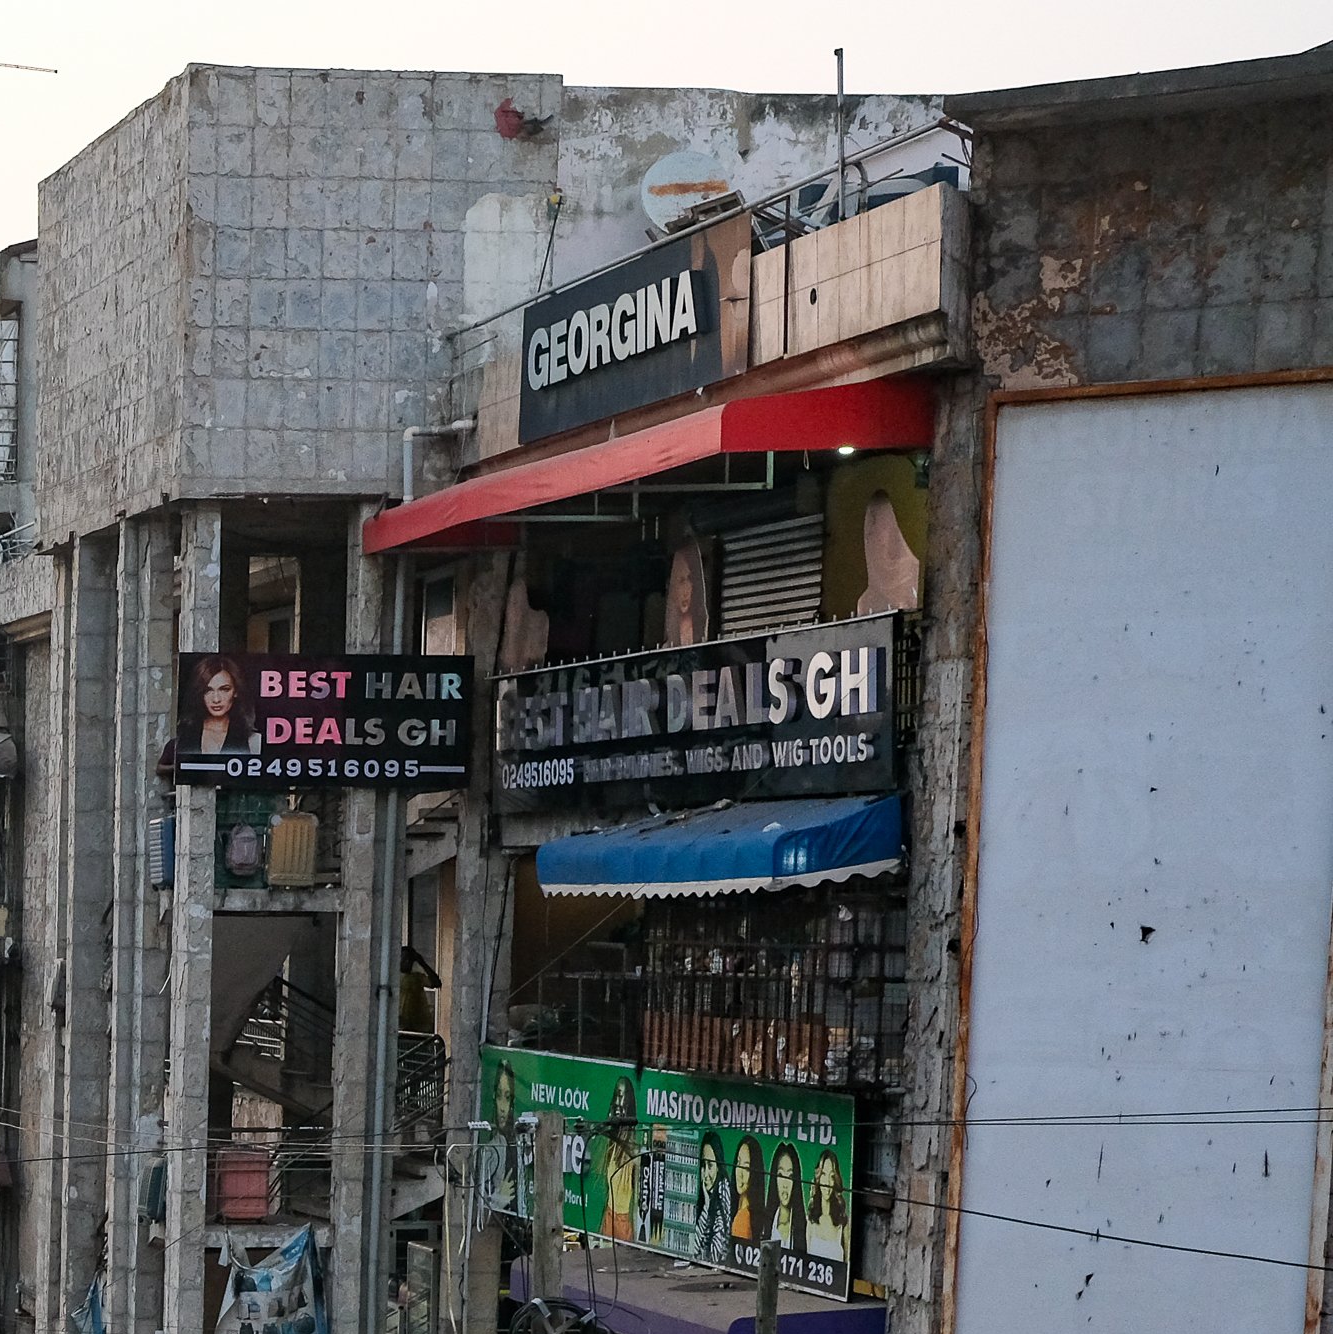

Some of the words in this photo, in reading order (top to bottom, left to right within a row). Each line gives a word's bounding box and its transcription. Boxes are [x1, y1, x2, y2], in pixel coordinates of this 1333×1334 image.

[528, 269, 698, 390] GEORGINA
[259, 670, 352, 699] BEST
[365, 672, 463, 700] HAIR
[667, 657, 793, 732] DEALS
[805, 646, 875, 720] GH
[266, 717, 386, 745] DEALS
[397, 718, 456, 746] GH
[226, 758, 420, 778] 0249516095
[502, 758, 575, 790] 0249516095
[772, 739, 804, 768] WIG
[809, 731, 868, 764] TOOLS
[531, 1082, 557, 1105] NEW
[558, 1087, 591, 1112] LOOK
[646, 1088, 705, 1124] MASITO
[708, 1097, 793, 1139] COMPANY
[797, 1111, 837, 1146] LTD.
[808, 1260, 833, 1286] 236
